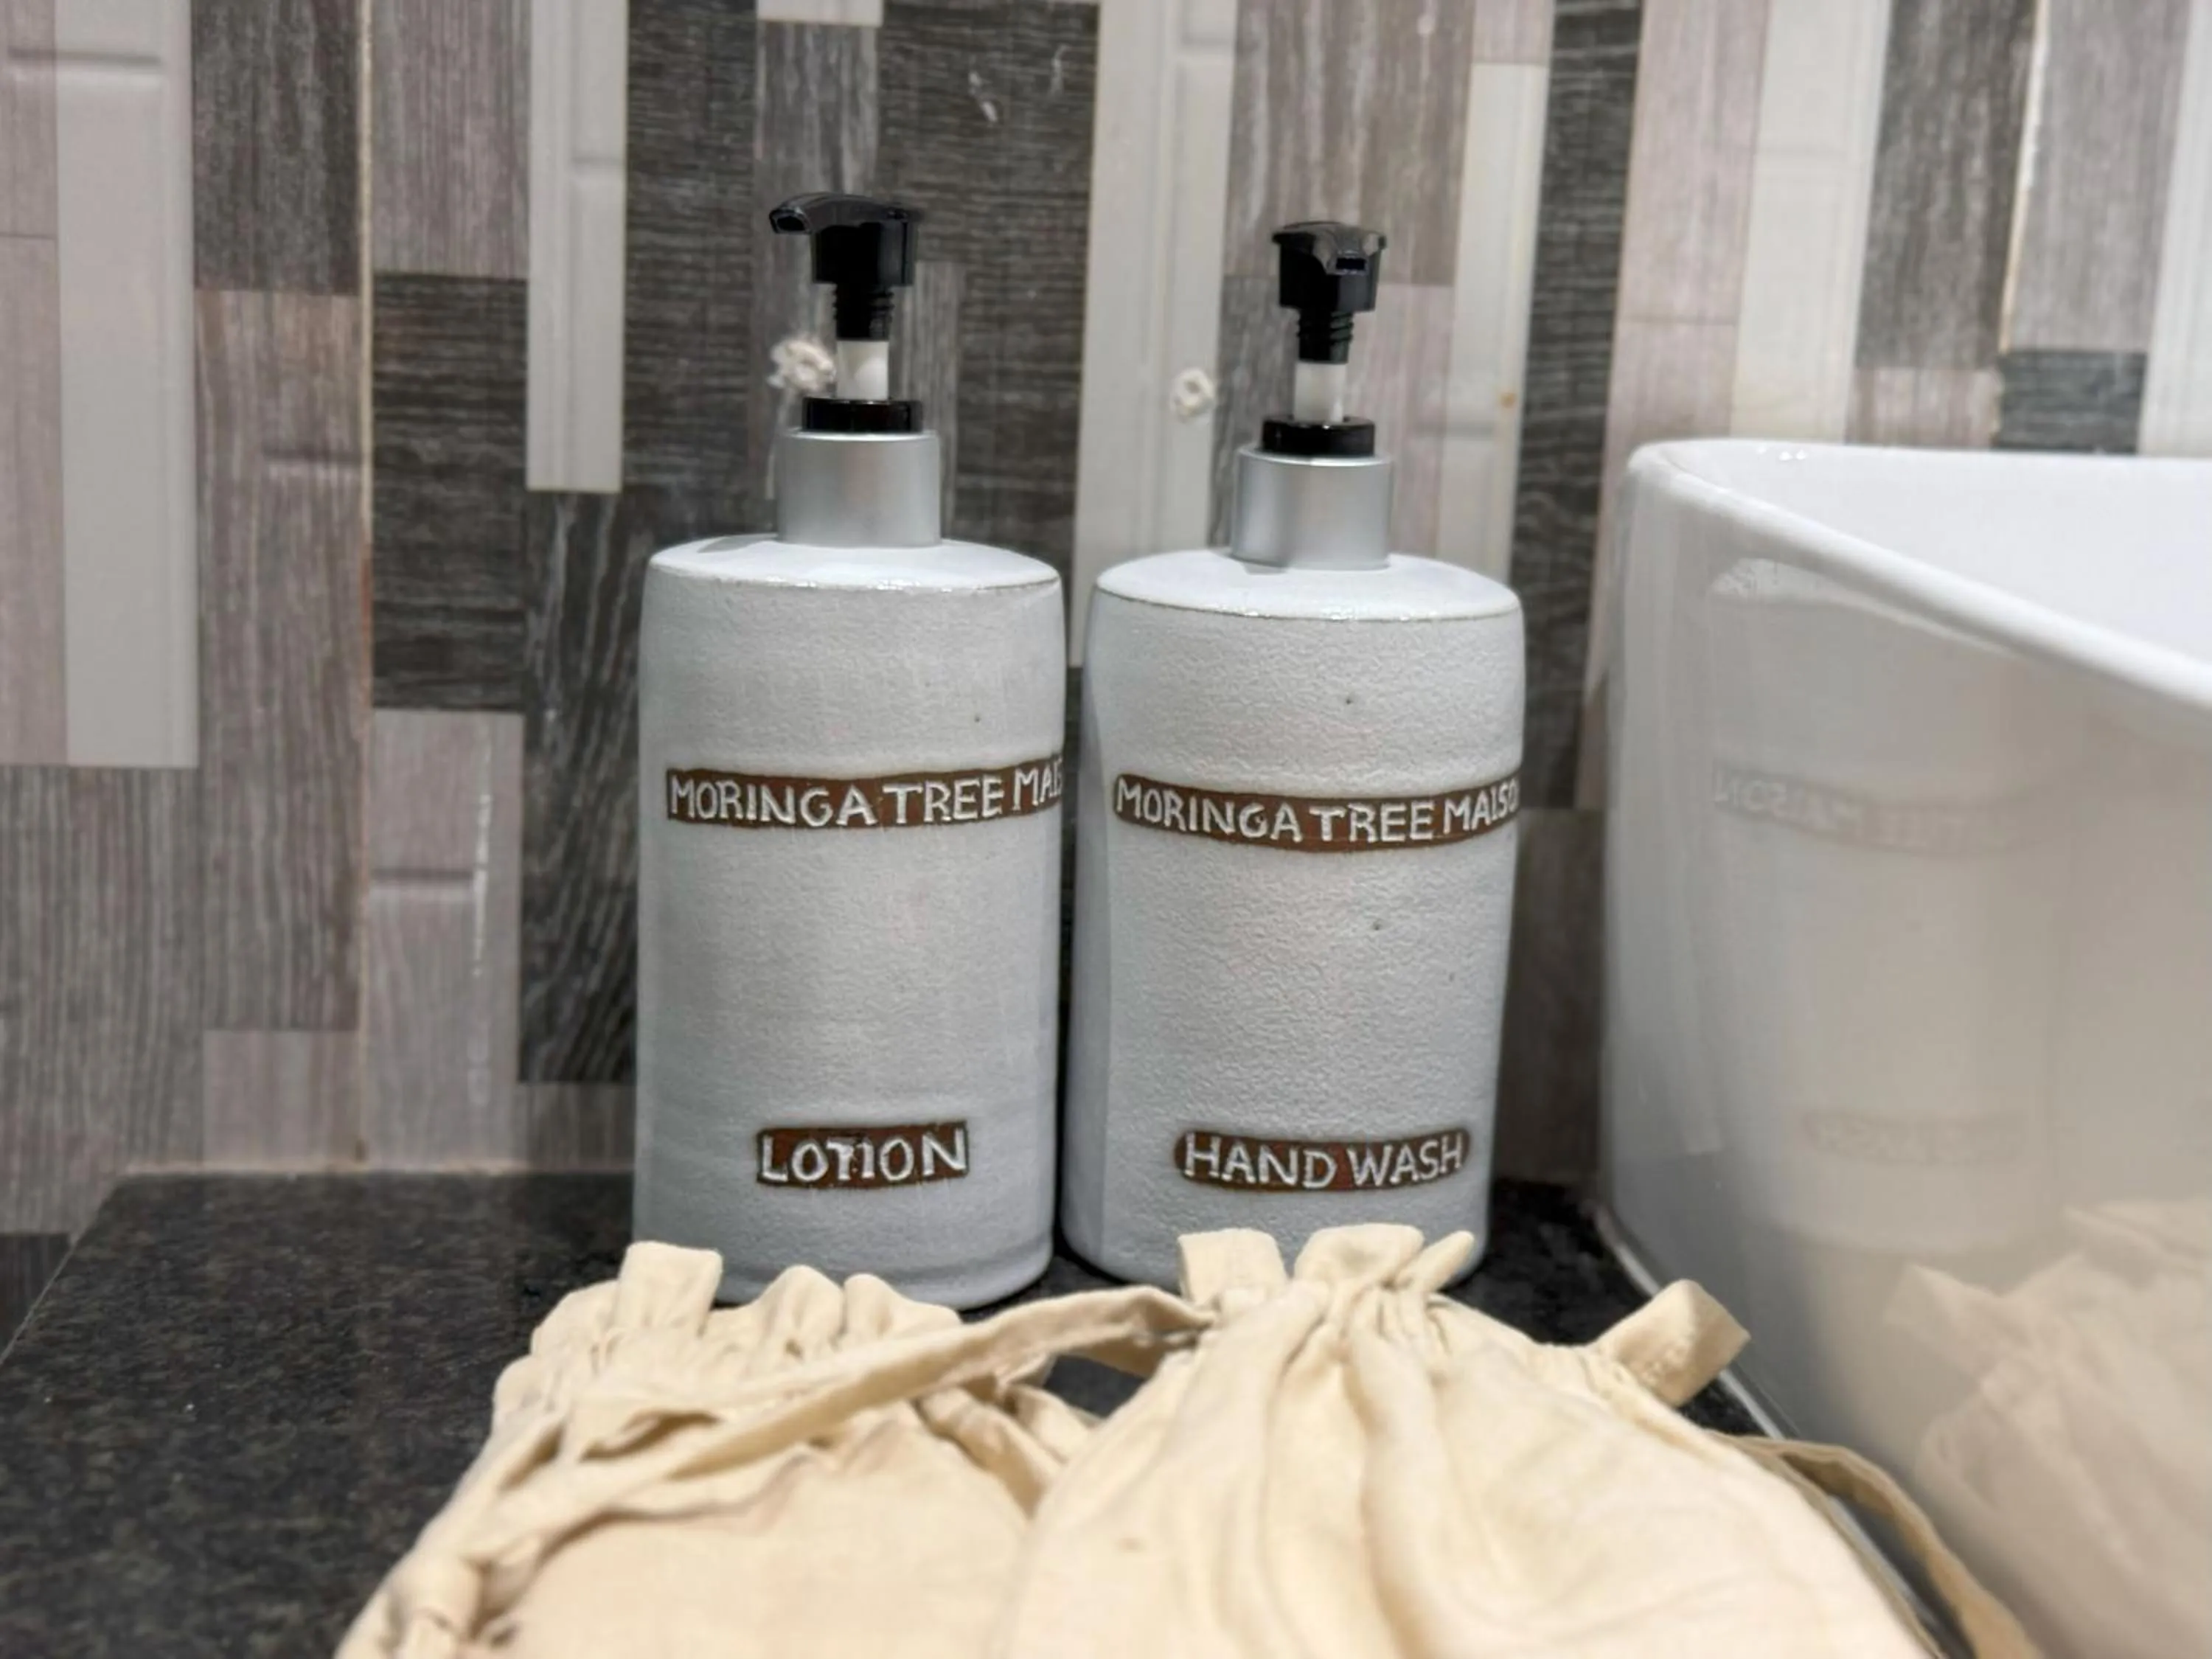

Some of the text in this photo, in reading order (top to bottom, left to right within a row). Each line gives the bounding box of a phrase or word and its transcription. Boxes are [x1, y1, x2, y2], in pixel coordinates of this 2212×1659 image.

[670, 777, 879, 827] MORINGA
[883, 777, 1004, 824] TREE
[1117, 779, 1301, 841] MORINGA
[1310, 801, 1434, 841] TREE
[762, 1128, 966, 1181] LOTION
[1183, 1133, 1463, 1188] HAND WASH
